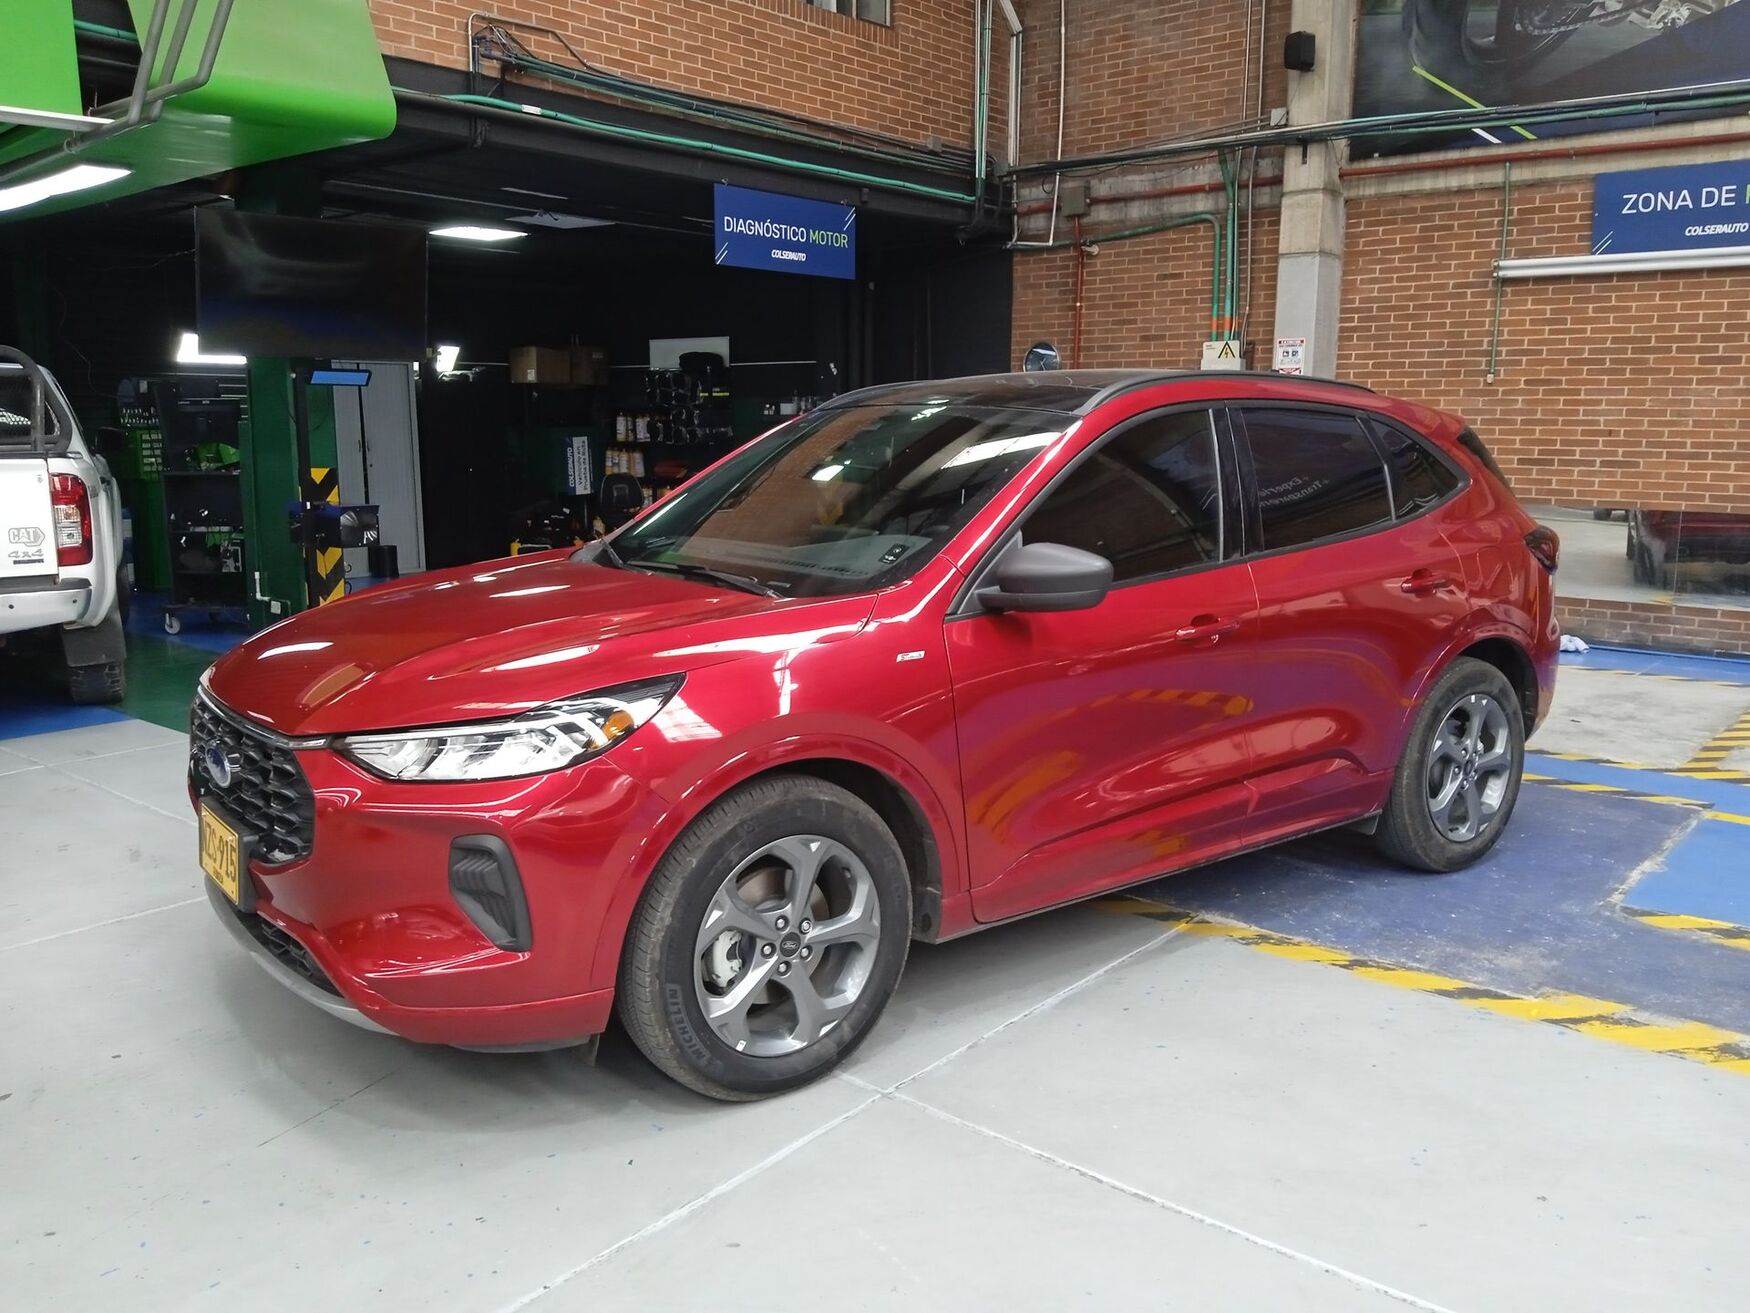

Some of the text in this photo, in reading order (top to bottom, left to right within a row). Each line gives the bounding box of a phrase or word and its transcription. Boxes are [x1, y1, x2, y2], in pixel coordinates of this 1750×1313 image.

[1621, 189, 1694, 215] ZONA
[1701, 185, 1737, 208] DE
[724, 215, 849, 249] DIAGNÓSTICO MOTOR
[1684, 222, 1750, 237] COLSERAUTO
[771, 249, 807, 262] COLSERAUTO
[666, 987, 707, 1061] MICHELIN
